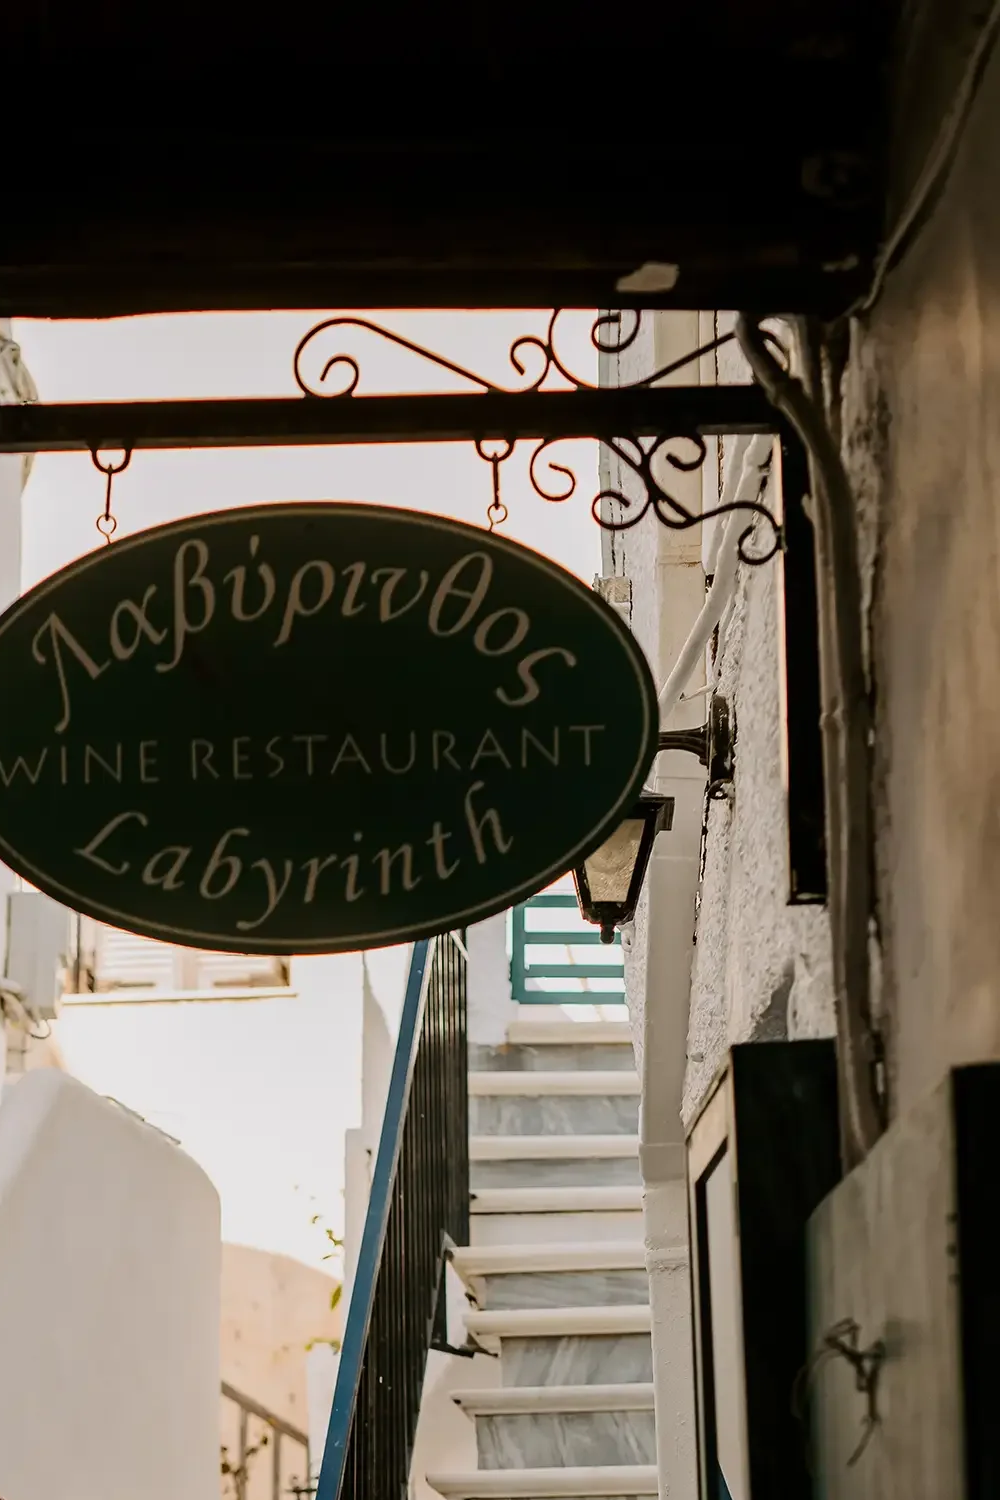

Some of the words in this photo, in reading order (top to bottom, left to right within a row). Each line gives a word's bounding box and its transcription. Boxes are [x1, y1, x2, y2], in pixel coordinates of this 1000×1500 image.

[31, 534, 578, 734] Λαβύρινθος
[190, 724, 606, 782] RESTAURANT
[73, 780, 514, 932] Labyrinth
